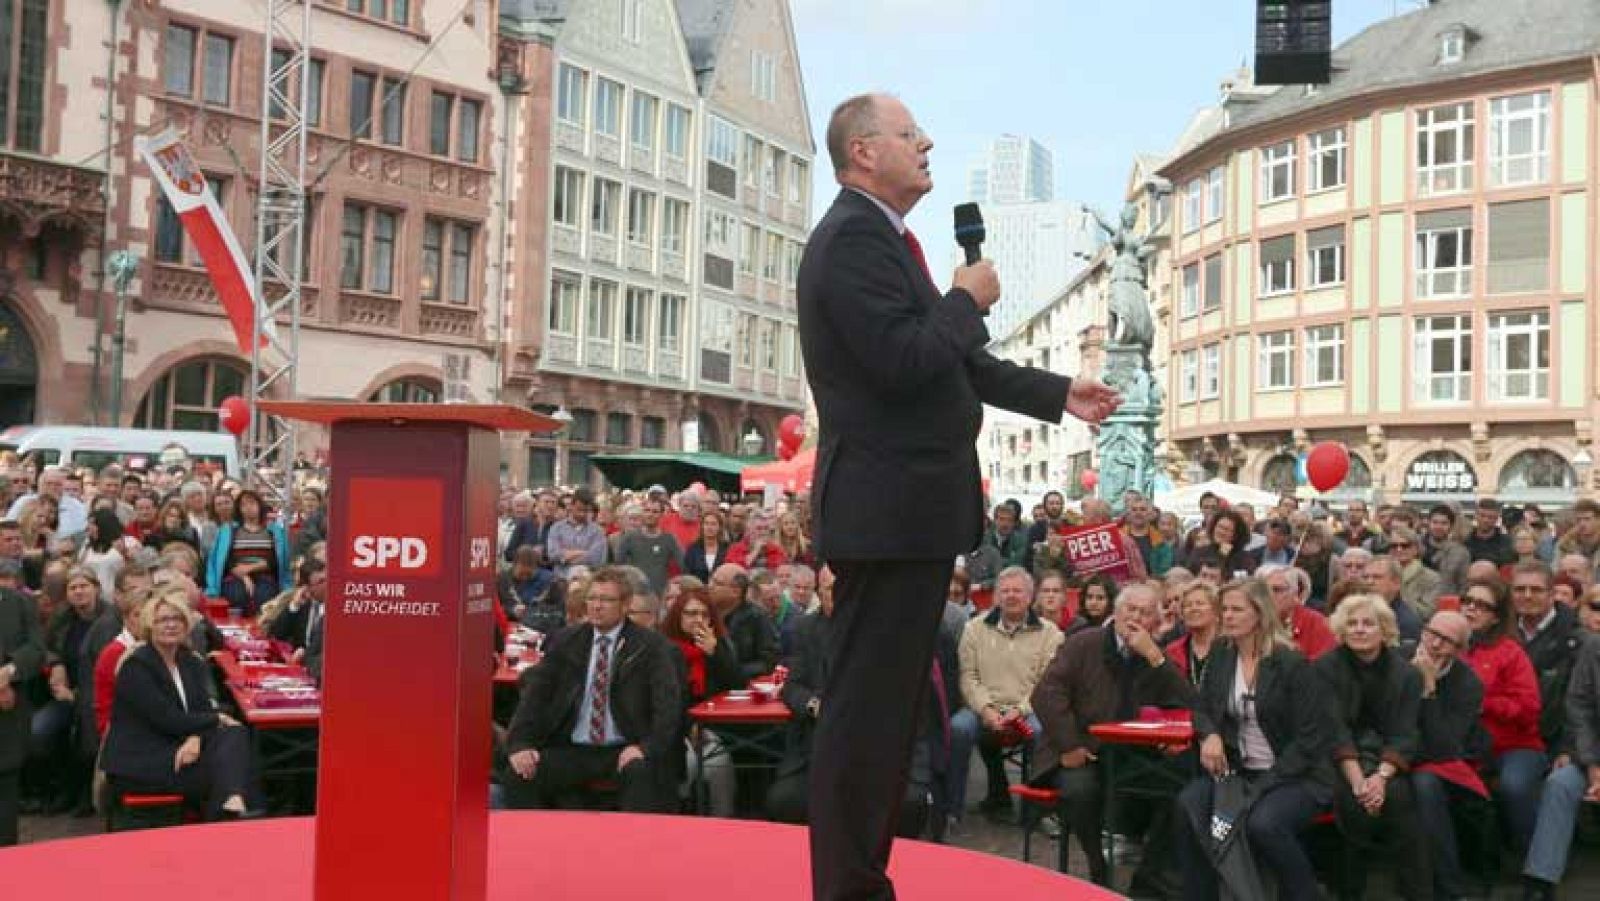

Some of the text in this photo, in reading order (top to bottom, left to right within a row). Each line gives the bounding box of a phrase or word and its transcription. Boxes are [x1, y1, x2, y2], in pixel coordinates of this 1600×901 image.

[1407, 473, 1472, 489] WEISS
[352, 535, 428, 568] SPD
[470, 537, 491, 569] SPD
[1068, 531, 1116, 560] PEER
[344, 582, 406, 598] DAS WIR
